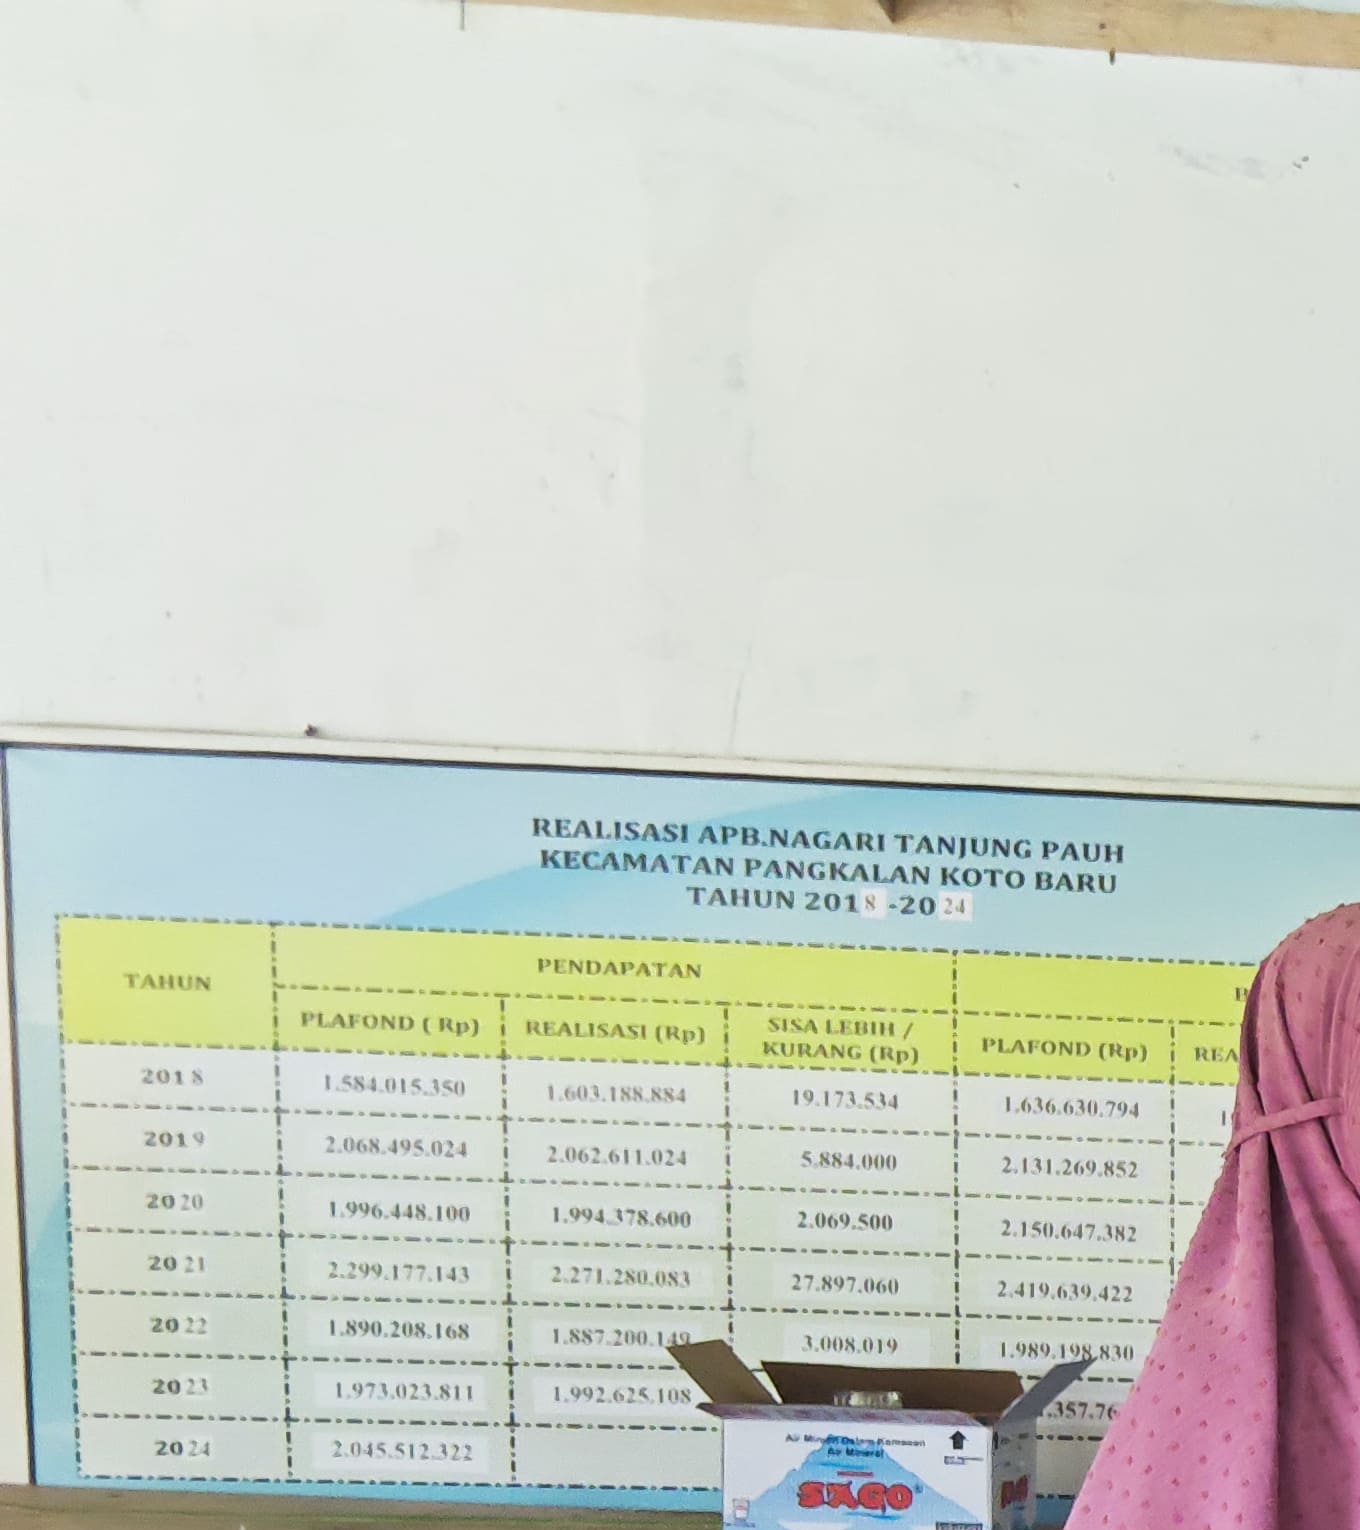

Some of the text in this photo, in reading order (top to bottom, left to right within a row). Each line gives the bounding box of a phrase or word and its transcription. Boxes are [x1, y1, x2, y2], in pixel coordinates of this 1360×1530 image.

[532, 816, 1126, 865] REALISASI APB.NAGARI TANJUNG PAUH
[539, 847, 1119, 895] KECAMATAN PANGKALAN KOTO BARU
[686, 885, 796, 911] TAHUN
[123, 969, 213, 994] TAHUN
[537, 956, 704, 983] PENDAPATAN
[302, 1010, 415, 1032] PLAFOND
[526, 1019, 706, 1048] REALISASI (Rp)
[767, 1016, 817, 1036] SISA
[825, 1019, 895, 1041] LEBIH
[762, 1040, 921, 1067] KURANG (Rp)
[982, 1037, 1148, 1064] PLAFOND (Rp)
[140, 1066, 205, 1088] 2018
[322, 1072, 467, 1100] 1.584.015.350
[545, 1083, 688, 1106] 1.603.188.884
[790, 1087, 900, 1113] 19.173.534
[1003, 1094, 1141, 1120] 1.636.630.794
[142, 1128, 207, 1150] 2019
[324, 1134, 469, 1160] 2.068.495.024
[546, 1145, 688, 1168] 2.062.611.024
[799, 1151, 898, 1173] 5.884.000
[1000, 1154, 1139, 1180] 2.131.269.852
[145, 1192, 205, 1212] 2020
[327, 1200, 472, 1225] 1.996.448.100
[550, 1205, 693, 1231] 1.994.378.600
[796, 1210, 894, 1234] 2.069.500
[1000, 1218, 1138, 1244] 2.150.647.382
[146, 1254, 208, 1276] 2021
[326, 1260, 472, 1286] 2.299.177.143
[550, 1265, 691, 1291] 2.271.280.083
[790, 1274, 901, 1299] 27.897.060
[996, 1280, 1134, 1304] 2.419.639.422
[149, 1316, 209, 1337] 2022
[327, 1318, 472, 1343] 1.890.208.168
[803, 1334, 899, 1357] 3.008.019
[999, 1342, 1135, 1365] 1.989.198830
[151, 1377, 210, 1398] 2023
[333, 1381, 475, 1405] 1.973.023.811
[552, 1384, 693, 1408] 1.992.625.108
[153, 1439, 212, 1460] 2024
[330, 1440, 474, 1466] 2.045.512.322
